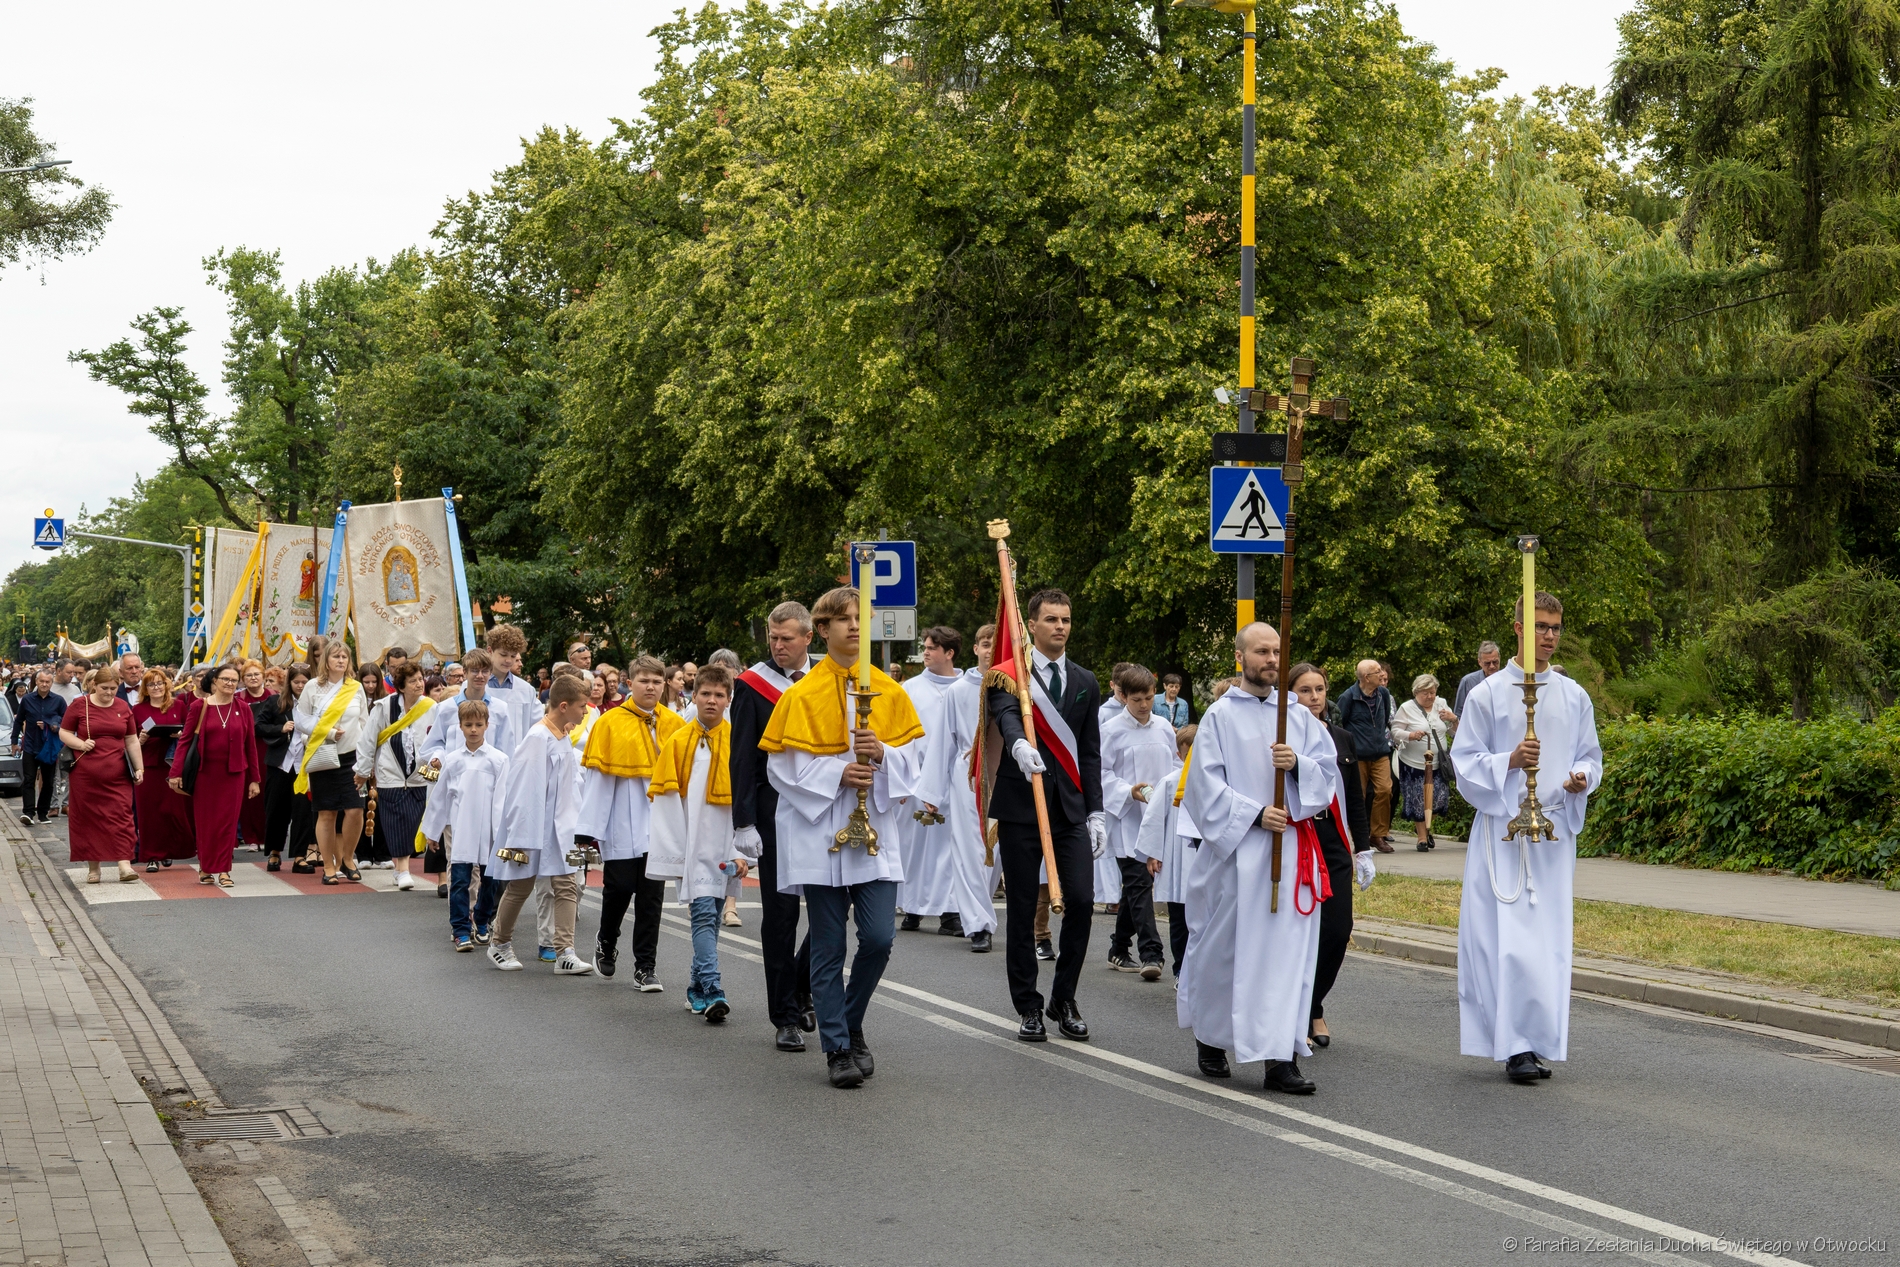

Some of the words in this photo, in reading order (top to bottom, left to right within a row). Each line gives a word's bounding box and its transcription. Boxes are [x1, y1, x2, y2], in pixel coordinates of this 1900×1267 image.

[359, 544, 373, 576] MATKO
[372, 526, 391, 543] BOŻA
[368, 533, 394, 574] PATRONKO
[400, 532, 432, 567] OTWOCKA
[301, 619, 316, 627] NAM
[369, 601, 390, 622] MÓDL
[393, 617, 405, 628] SIĘ
[409, 614, 419, 624] ZA
[419, 594, 438, 616] NAMI
